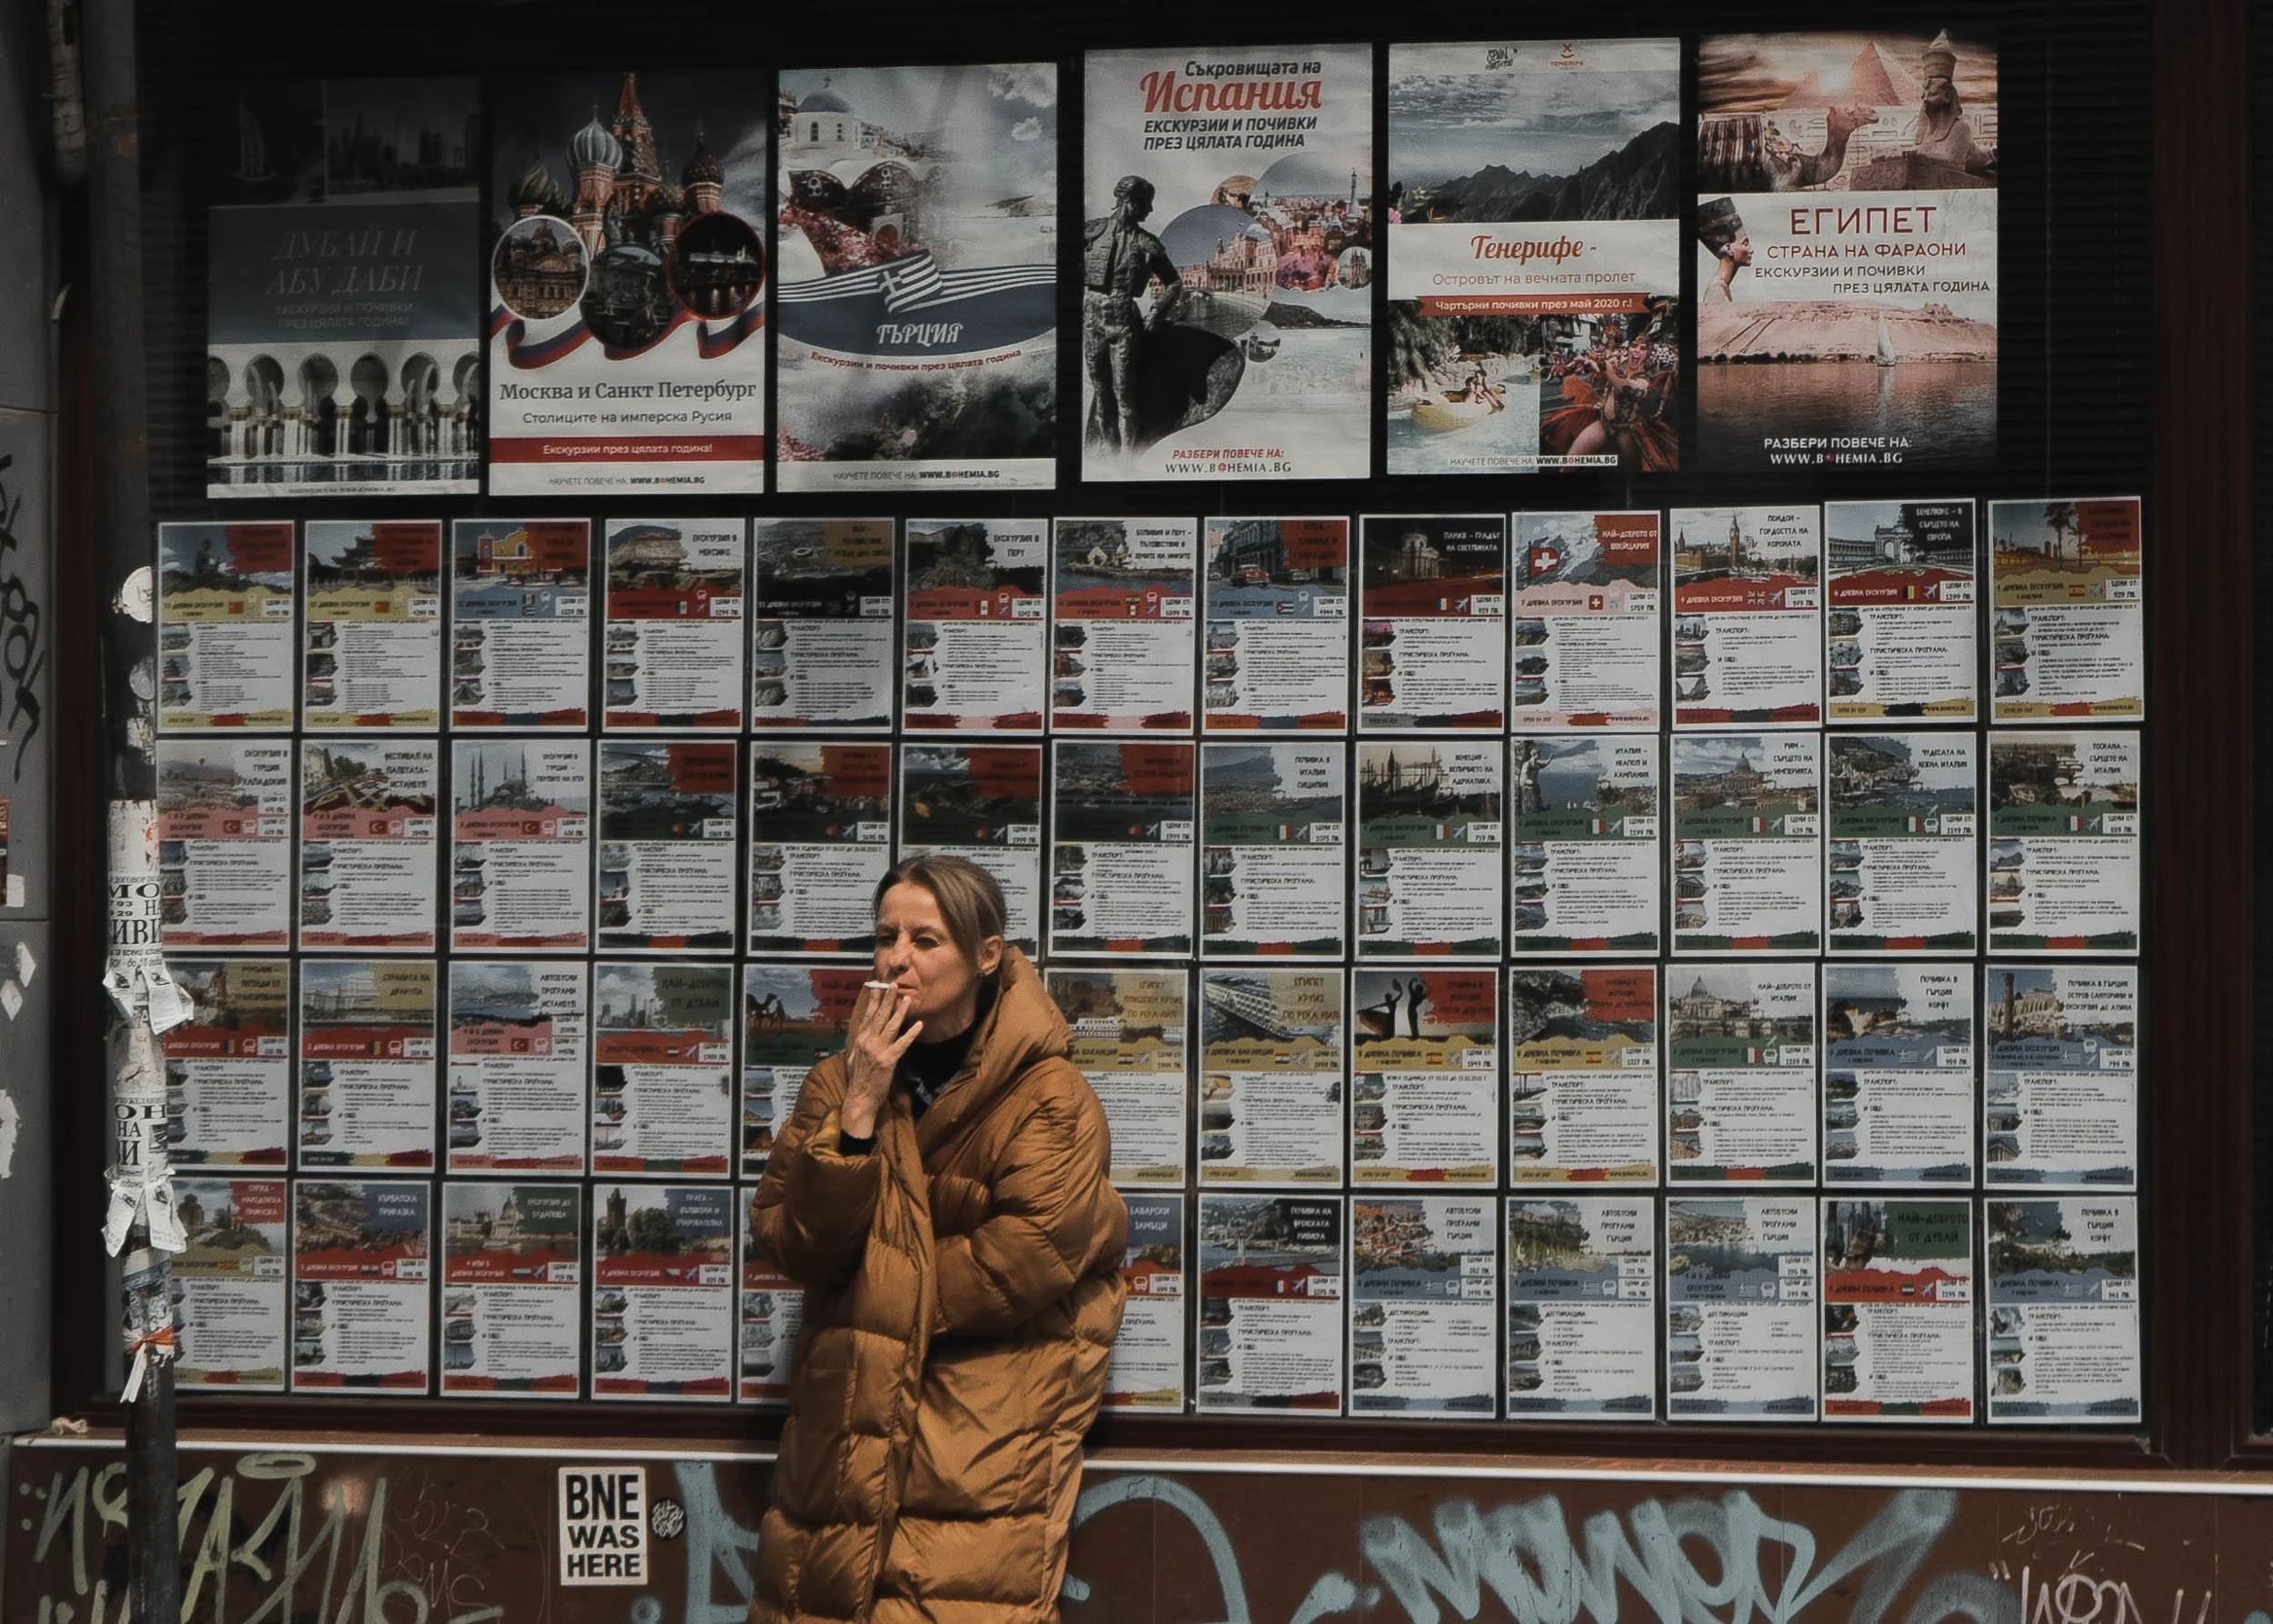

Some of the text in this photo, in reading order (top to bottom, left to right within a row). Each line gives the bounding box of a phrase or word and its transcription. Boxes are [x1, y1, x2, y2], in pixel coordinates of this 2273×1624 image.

[1186, 61, 1321, 79] Съкровищата на
[1139, 71, 1322, 113] Испания
[1145, 116, 1317, 133] ЕКСКУРЗИИ И ПОЧИВКИ
[1145, 134, 1304, 151] ПРЕЗ ЦЯЛАТА ГОДИНА
[1791, 206, 1937, 235] ЕГИПЕТ
[272, 226, 418, 262] ДУБАЙ И
[1470, 236, 1584, 266] Тенерифе
[1767, 243, 1966, 258] СТРАНА НА ФАРАОНИ
[1433, 272, 1635, 286] Островът на вечната пролет
[1756, 266, 1925, 278] ЕКСКУРЗИИ И ПОЧИВКИ
[264, 264, 425, 297] АБУ ДАБИ
[1834, 281, 1989, 294] ПРЕЗ ЦЯЛАТА ГОДИНА
[1436, 301, 1489, 311] Чартърни
[1493, 300, 1538, 310] почивки
[1541, 300, 1567, 310] през
[1570, 299, 1591, 308] май
[1594, 299, 1619, 308] 2020
[810, 351, 863, 369] Екскурзии
[875, 363, 919, 371] почивки
[921, 364, 946, 372] през
[948, 360, 983, 369] цялата
[986, 350, 1021, 365] година
[500, 380, 756, 401] Москва и Санкт Петербург
[523, 411, 732, 425] Столиците на имперска Русия
[544, 444, 713, 456] Екскурзии през цялата година!
[1764, 438, 1827, 448] РАЗБЕРИ
[1831, 437, 1886, 448] ПОВЕЧЕ
[1173, 449, 1285, 459] РАЗБЕРИ ПОВЕЧЕ НА:
[1450, 458, 1486, 466] НАУЧЕТЕ
[1537, 456, 1617, 465] WWW.BOHEMIA.BG
[1770, 453, 1902, 464] WWW.BOHEMIA.BG
[870, 472, 902, 480] ПОВЕЧЕ
[919, 471, 999, 479] WWW.BOHEMIA.BG
[1166, 462, 1292, 473] WWW.BOHEMIA.BG
[566, 1474, 639, 1520] BNE
[567, 1525, 639, 1549] WAS
[567, 1554, 641, 1577] HERE
